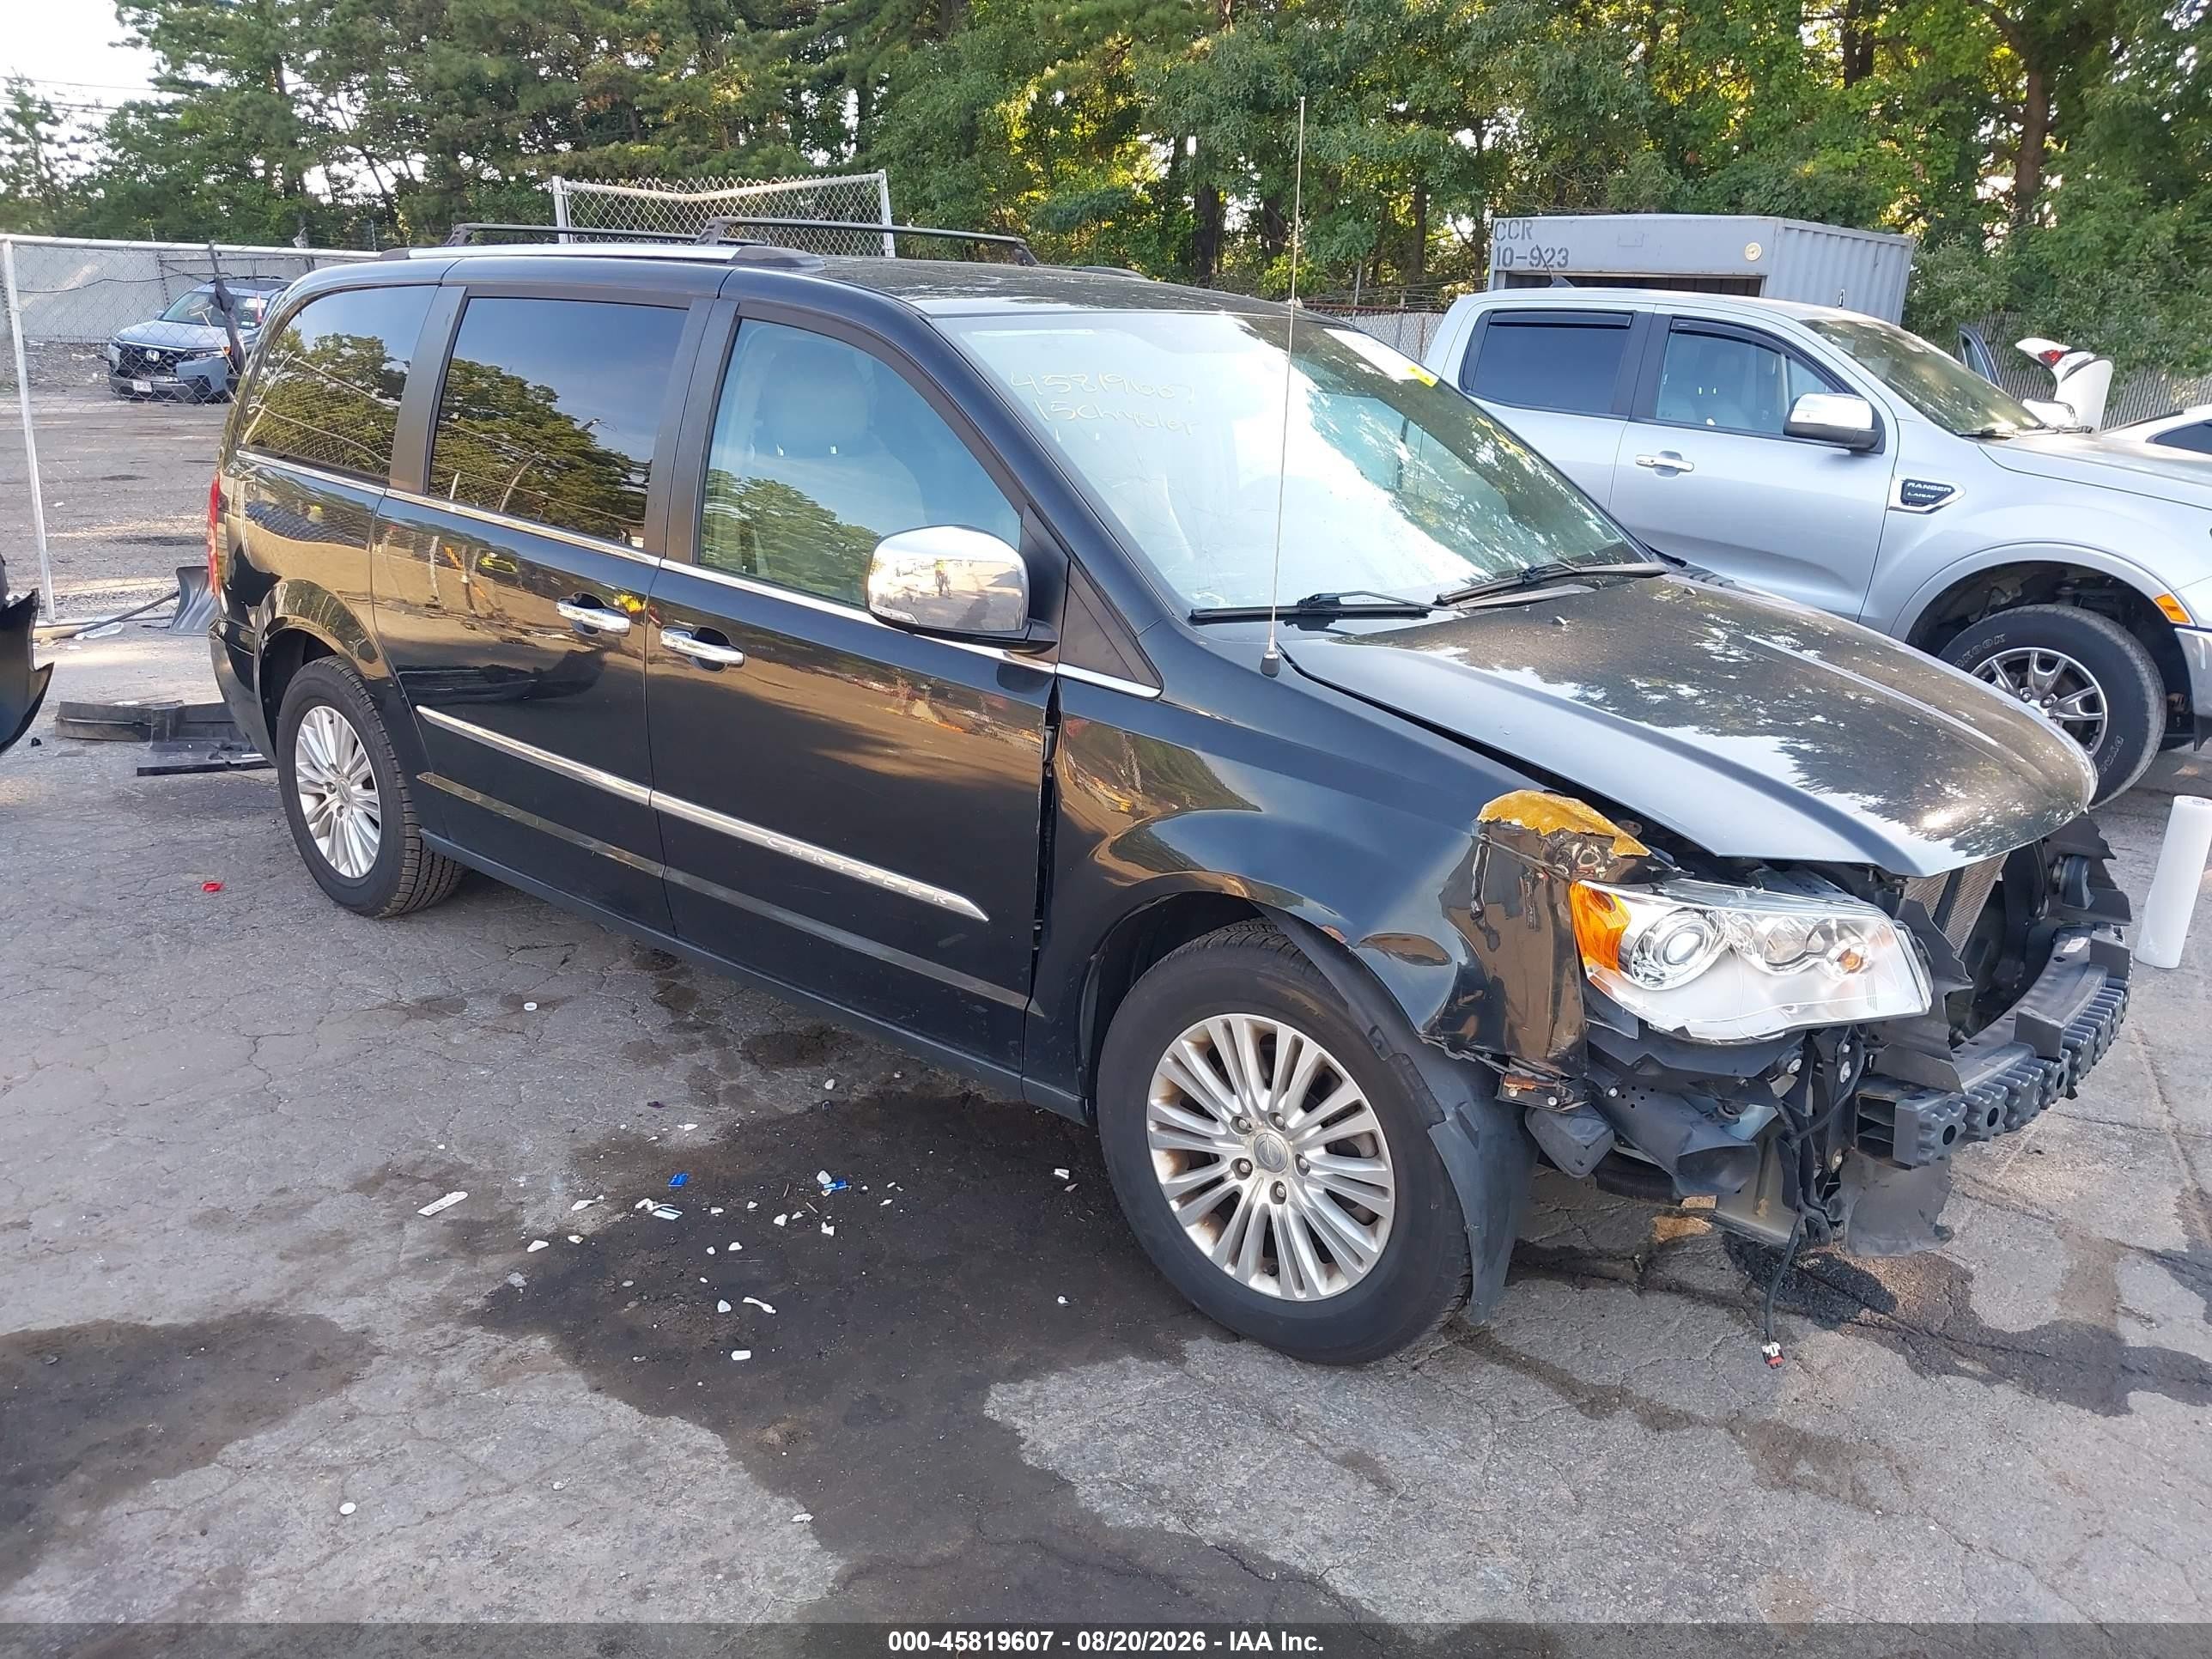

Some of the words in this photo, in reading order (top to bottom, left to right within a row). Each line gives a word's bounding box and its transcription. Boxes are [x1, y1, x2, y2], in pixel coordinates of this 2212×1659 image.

[1494, 219, 1534, 241] CCR
[1496, 246, 1570, 269] 10-923
[1907, 482, 1952, 493] RANGER
